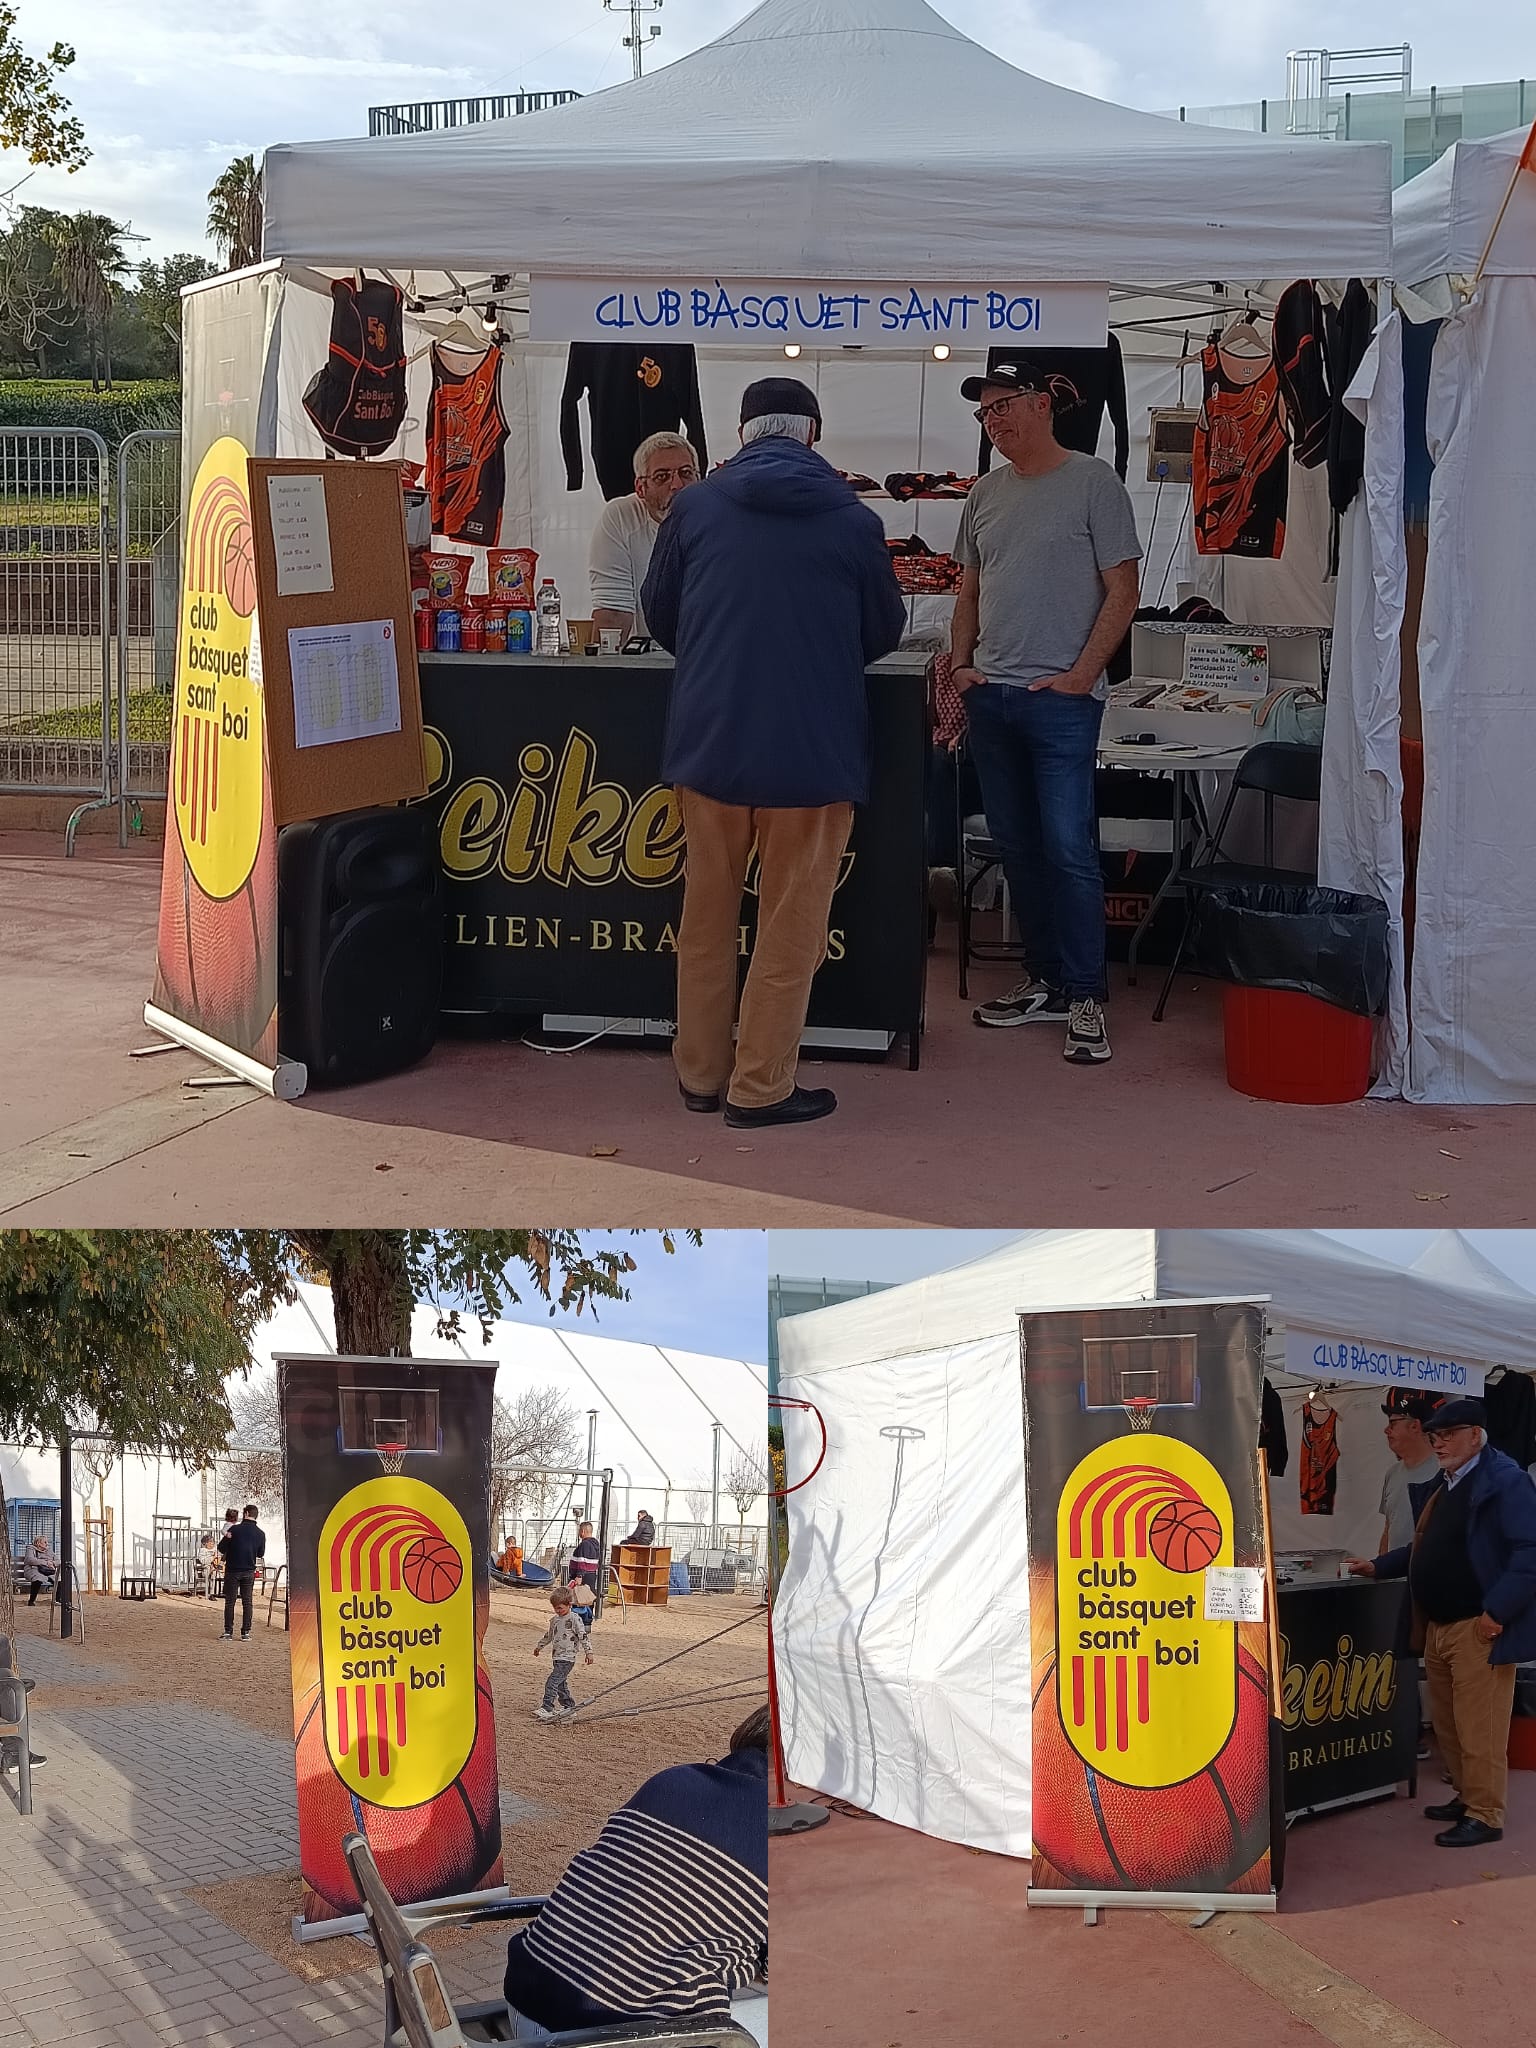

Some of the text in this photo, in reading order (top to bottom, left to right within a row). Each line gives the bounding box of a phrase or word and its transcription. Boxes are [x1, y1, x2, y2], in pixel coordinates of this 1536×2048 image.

[595, 289, 682, 330] CLUB
[691, 279, 870, 332] BÀSQUET
[985, 291, 1041, 332] BOI
[353, 401, 379, 420] Sant
[190, 596, 218, 632] club
[188, 635, 249, 683] bàsquet
[1205, 672, 1215, 680] del
[187, 682, 217, 713] sant
[222, 702, 249, 740] boi
[1313, 1343, 1348, 1369] CLUB
[1350, 1340, 1415, 1378] BÀSQUET
[1449, 1361, 1467, 1386] BOI
[1078, 1561, 1137, 1588] club
[339, 1594, 393, 1620] club
[1078, 1592, 1197, 1626] bàsquet
[340, 1623, 442, 1654] bàsquet
[1079, 1625, 1141, 1650] sant
[1155, 1638, 1200, 1665] boi
[341, 1654, 398, 1680] sant
[410, 1663, 446, 1690] boi
